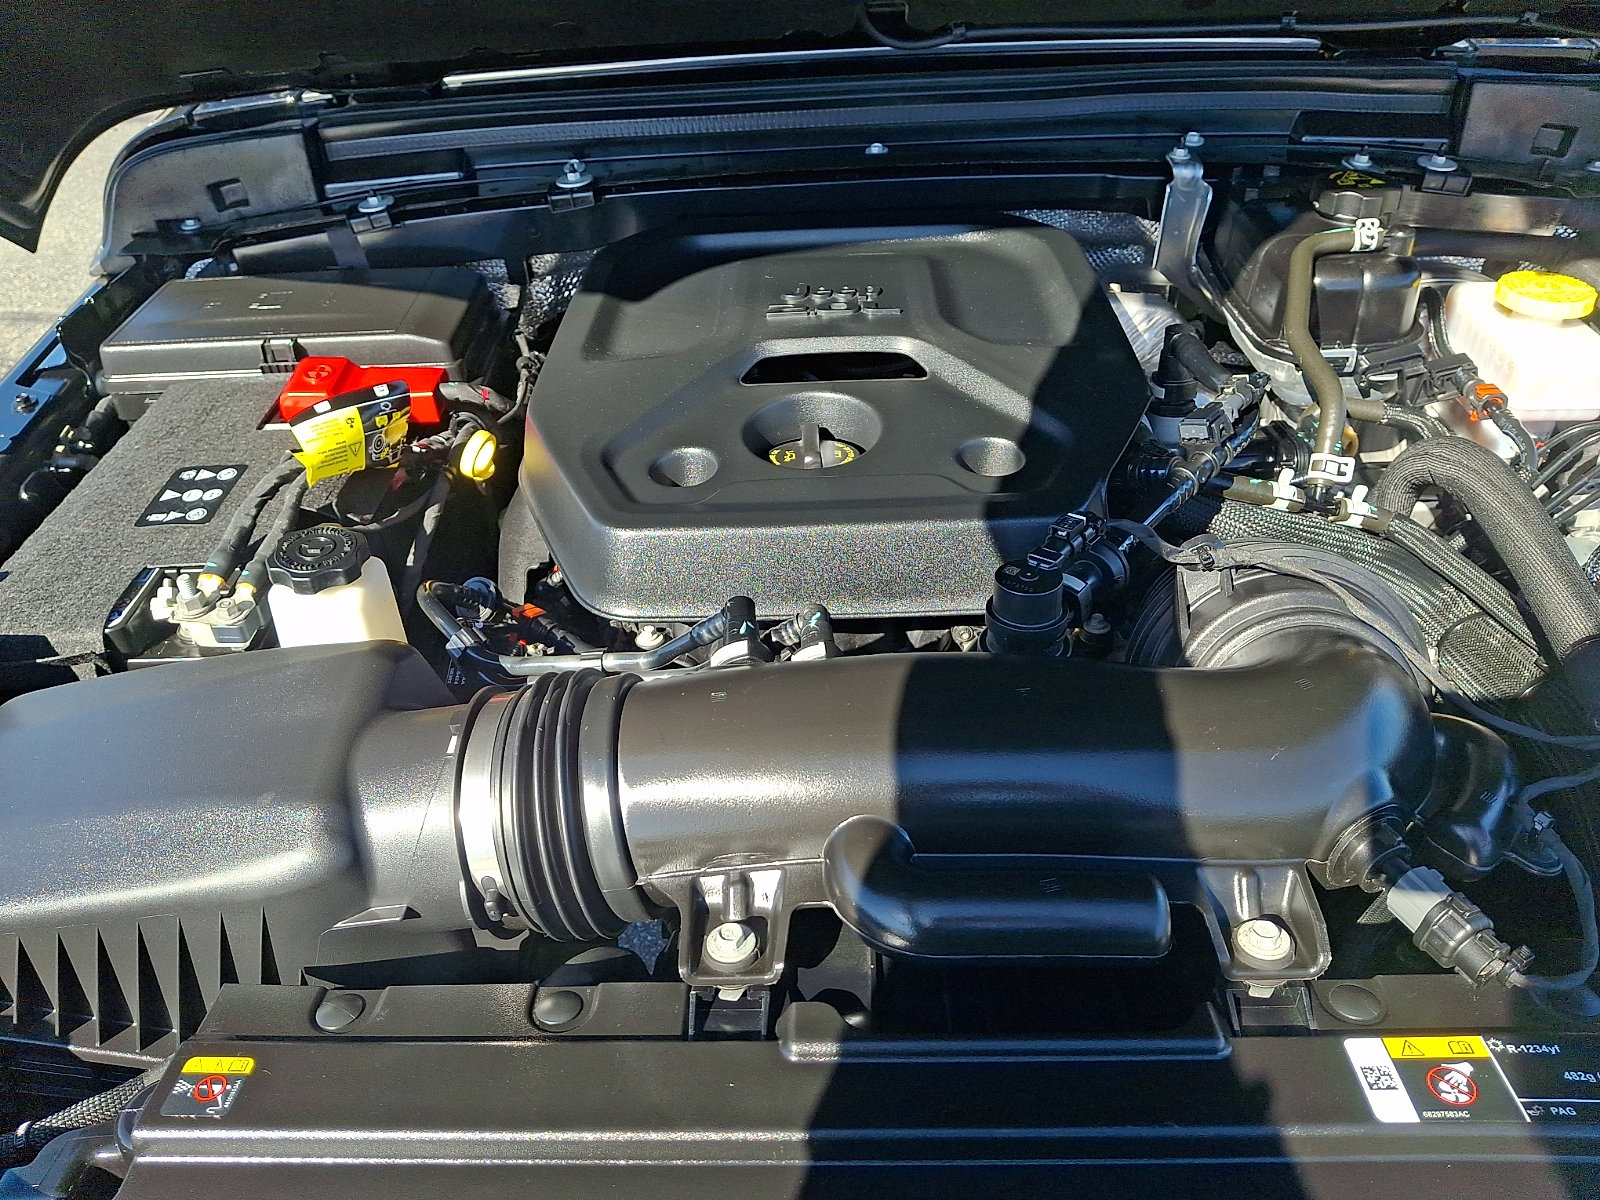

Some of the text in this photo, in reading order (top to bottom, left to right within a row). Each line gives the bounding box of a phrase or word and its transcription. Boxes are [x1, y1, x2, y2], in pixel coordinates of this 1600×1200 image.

[1505, 1044, 1561, 1055] R-1234yf
[1563, 1071, 1596, 1083] 482g
[1549, 1106, 1577, 1116] PAG
